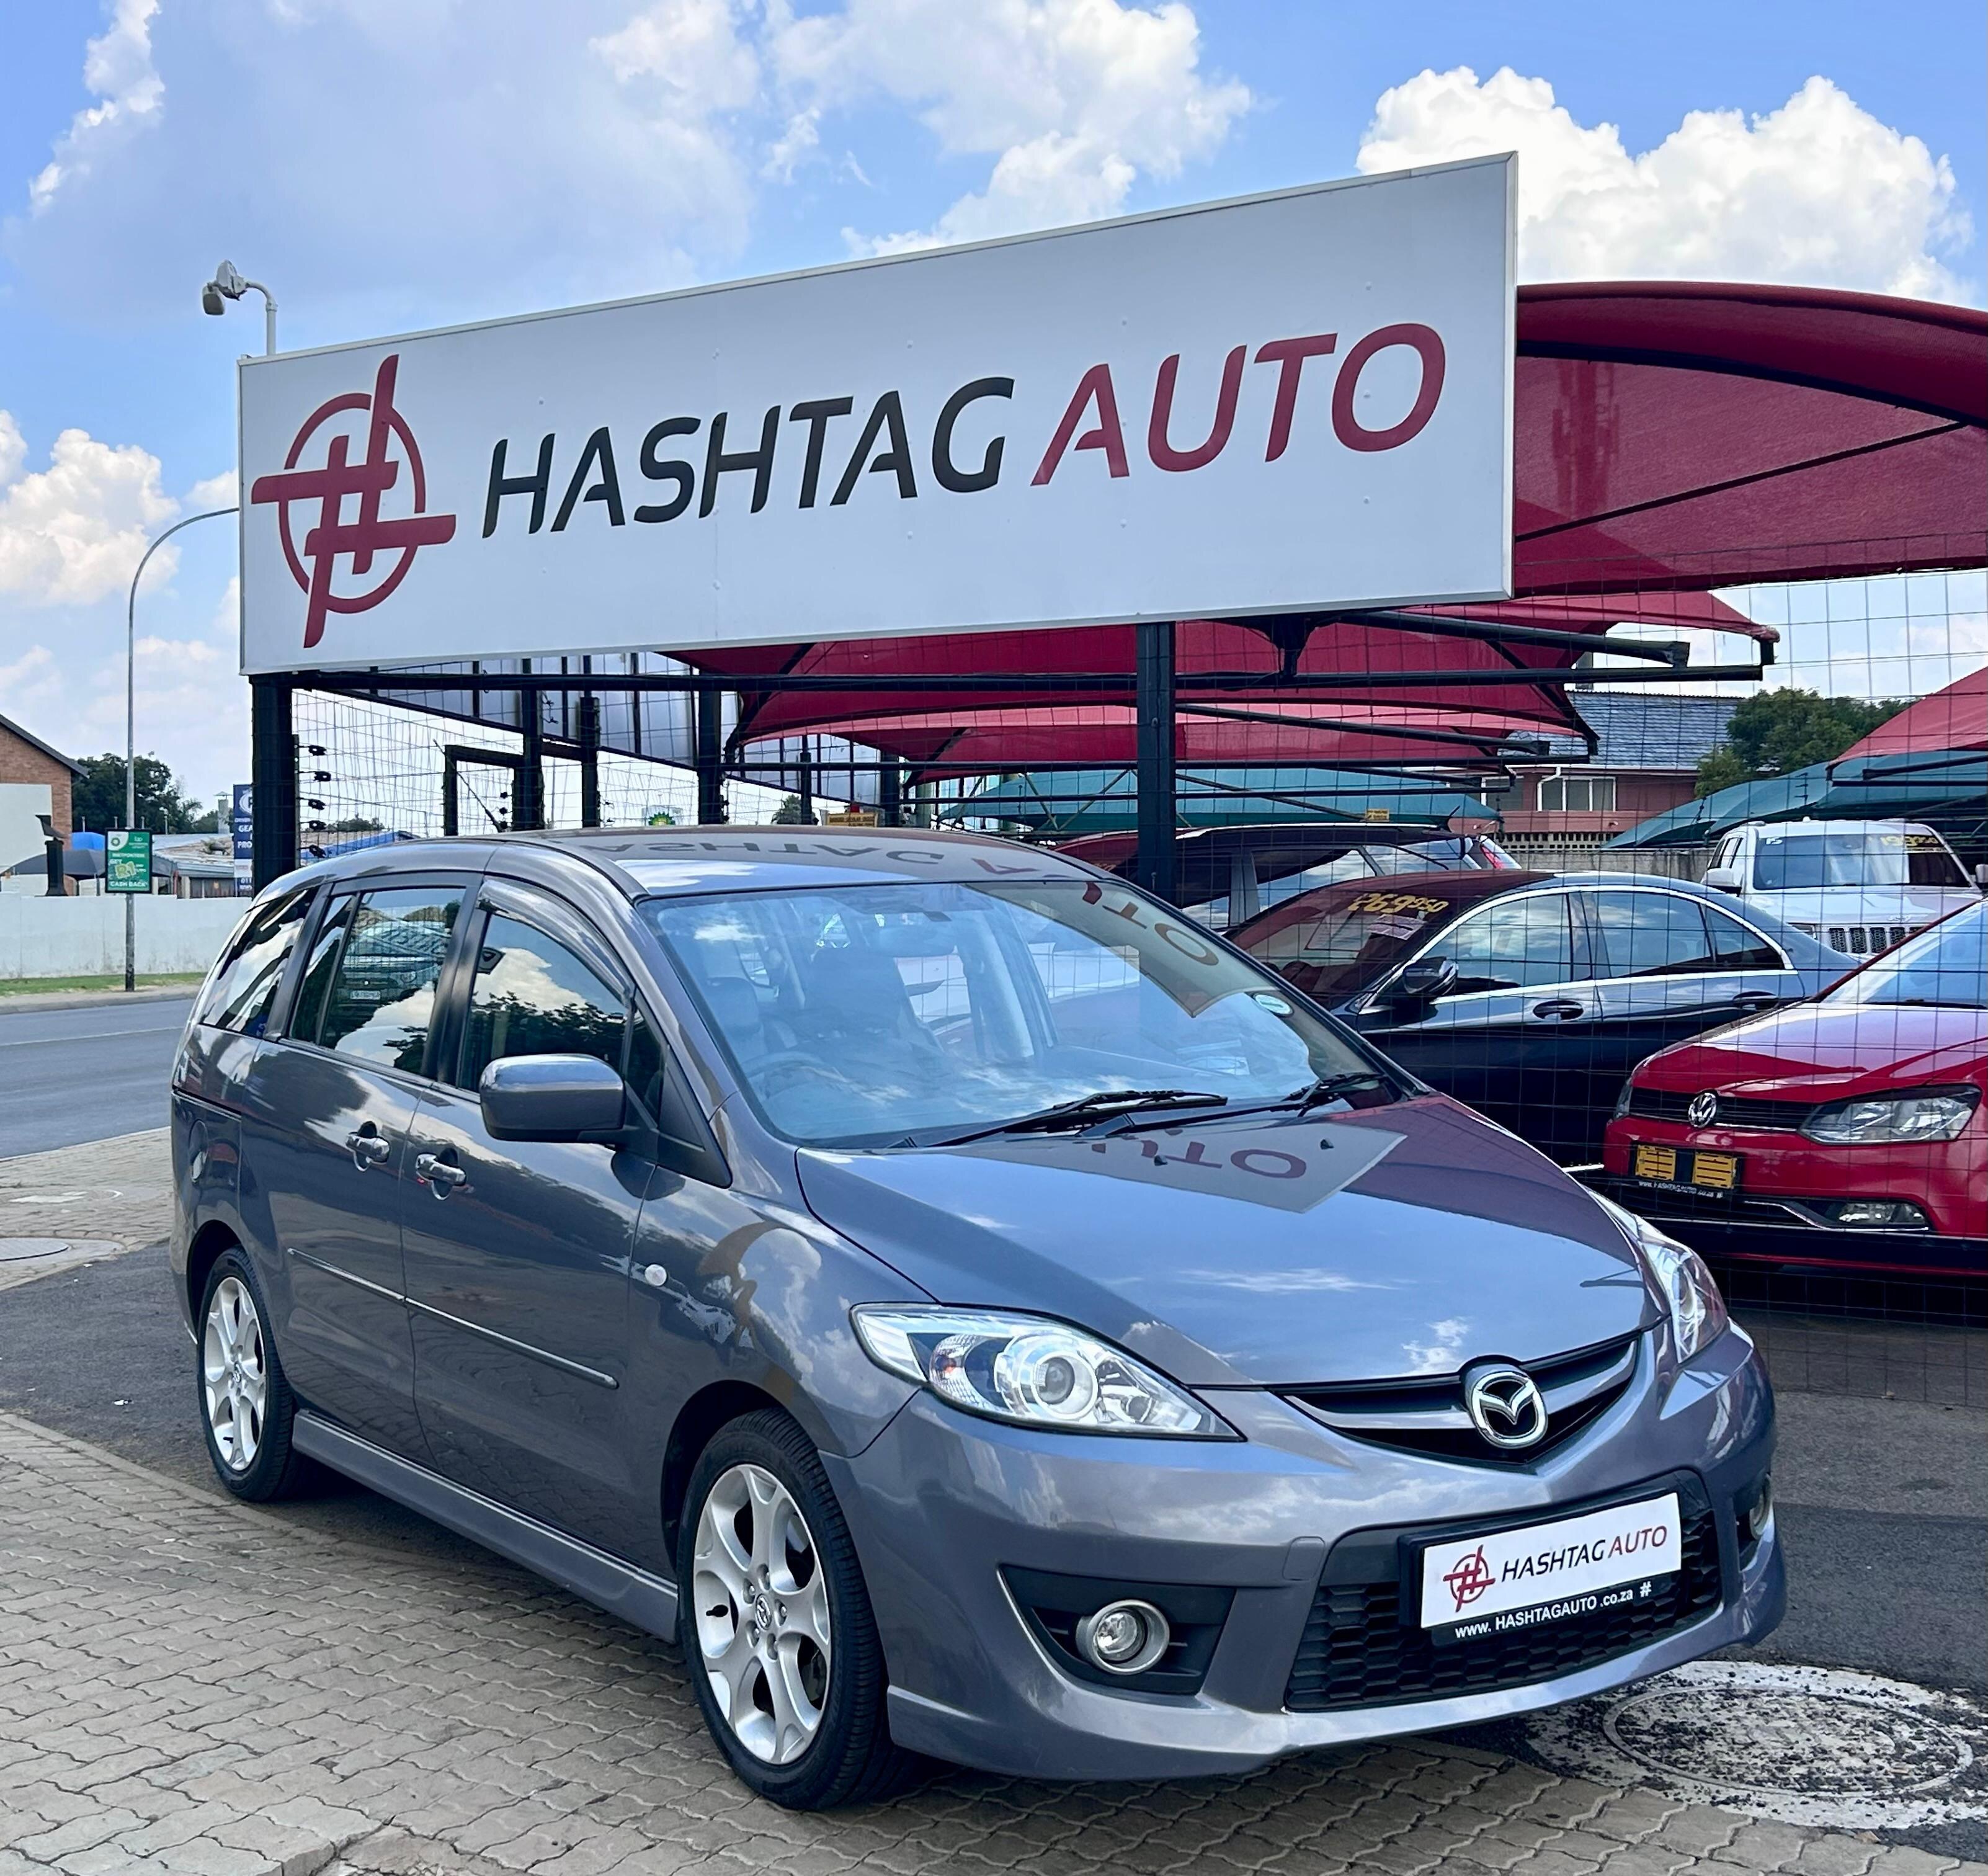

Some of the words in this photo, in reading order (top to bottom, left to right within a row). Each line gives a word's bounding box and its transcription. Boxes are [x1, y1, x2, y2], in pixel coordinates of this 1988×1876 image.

[483, 377, 1015, 539] HASHTAG
[1030, 323, 1445, 486] AUTO
[1501, 1539, 1606, 1582] HASHTAG
[1608, 1525, 1667, 1559] AUTO
[1455, 1622, 1492, 1638] www.
[1495, 1595, 1597, 1630] HASHTAGAUTO
